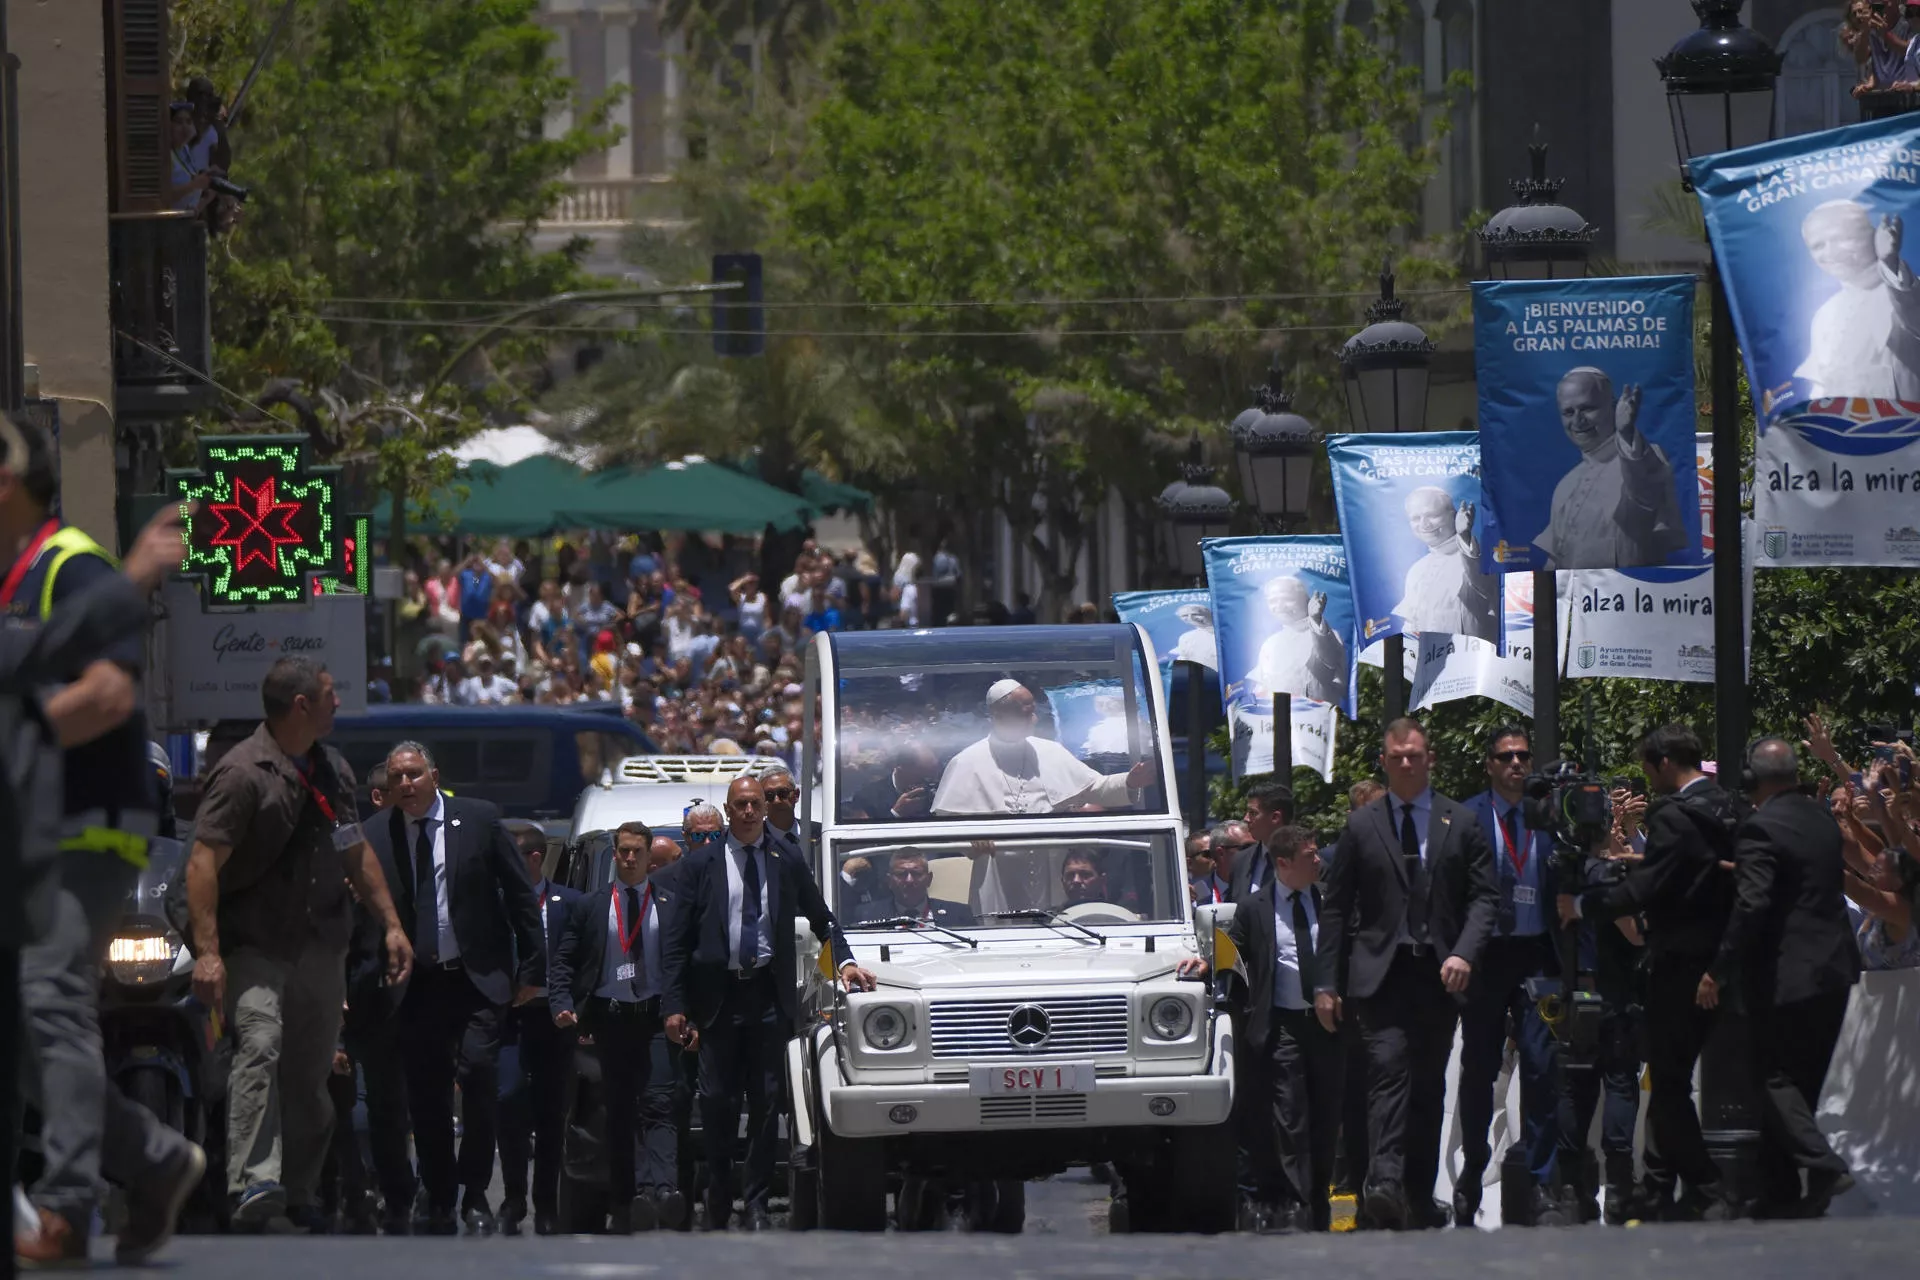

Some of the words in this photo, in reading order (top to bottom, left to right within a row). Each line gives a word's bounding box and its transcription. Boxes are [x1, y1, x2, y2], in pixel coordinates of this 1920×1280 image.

[1737, 188, 1753, 204] A
[1757, 168, 1796, 193] LAS
[1800, 149, 1892, 177] PALMAS
[1896, 149, 1920, 166] DE
[1746, 180, 1806, 213] GRAN
[1812, 165, 1917, 190] CANARIA!
[1525, 300, 1645, 320] ¡BIENVENIDO
[1505, 321, 1519, 335] A
[1523, 319, 1557, 335] LAS
[1563, 317, 1638, 333] PALMAS
[1642, 317, 1667, 332] DE
[1513, 337, 1566, 352] GRAN
[1570, 335, 1661, 350] CANARIA!
[1358, 459, 1369, 471] A
[1373, 455, 1402, 467] LAS
[1407, 454, 1469, 466] PALMAS
[1365, 466, 1410, 480] GRAN
[1768, 462, 1821, 492] alza
[1832, 461, 1854, 492] la
[1227, 557, 1237, 567] A
[1239, 553, 1266, 563] LAS
[1270, 552, 1326, 563] PALMAS
[1329, 554, 1347, 569] DE
[1232, 560, 1272, 575] GRAN
[1582, 588, 1625, 614] alza
[1635, 587, 1654, 614] la
[212, 622, 265, 663] Gente
[1600, 646, 1653, 655] Ayuntamiento
[1424, 641, 1456, 665] alza
[1003, 1068, 1044, 1089] SCV
[1055, 1067, 1062, 1089] 1
